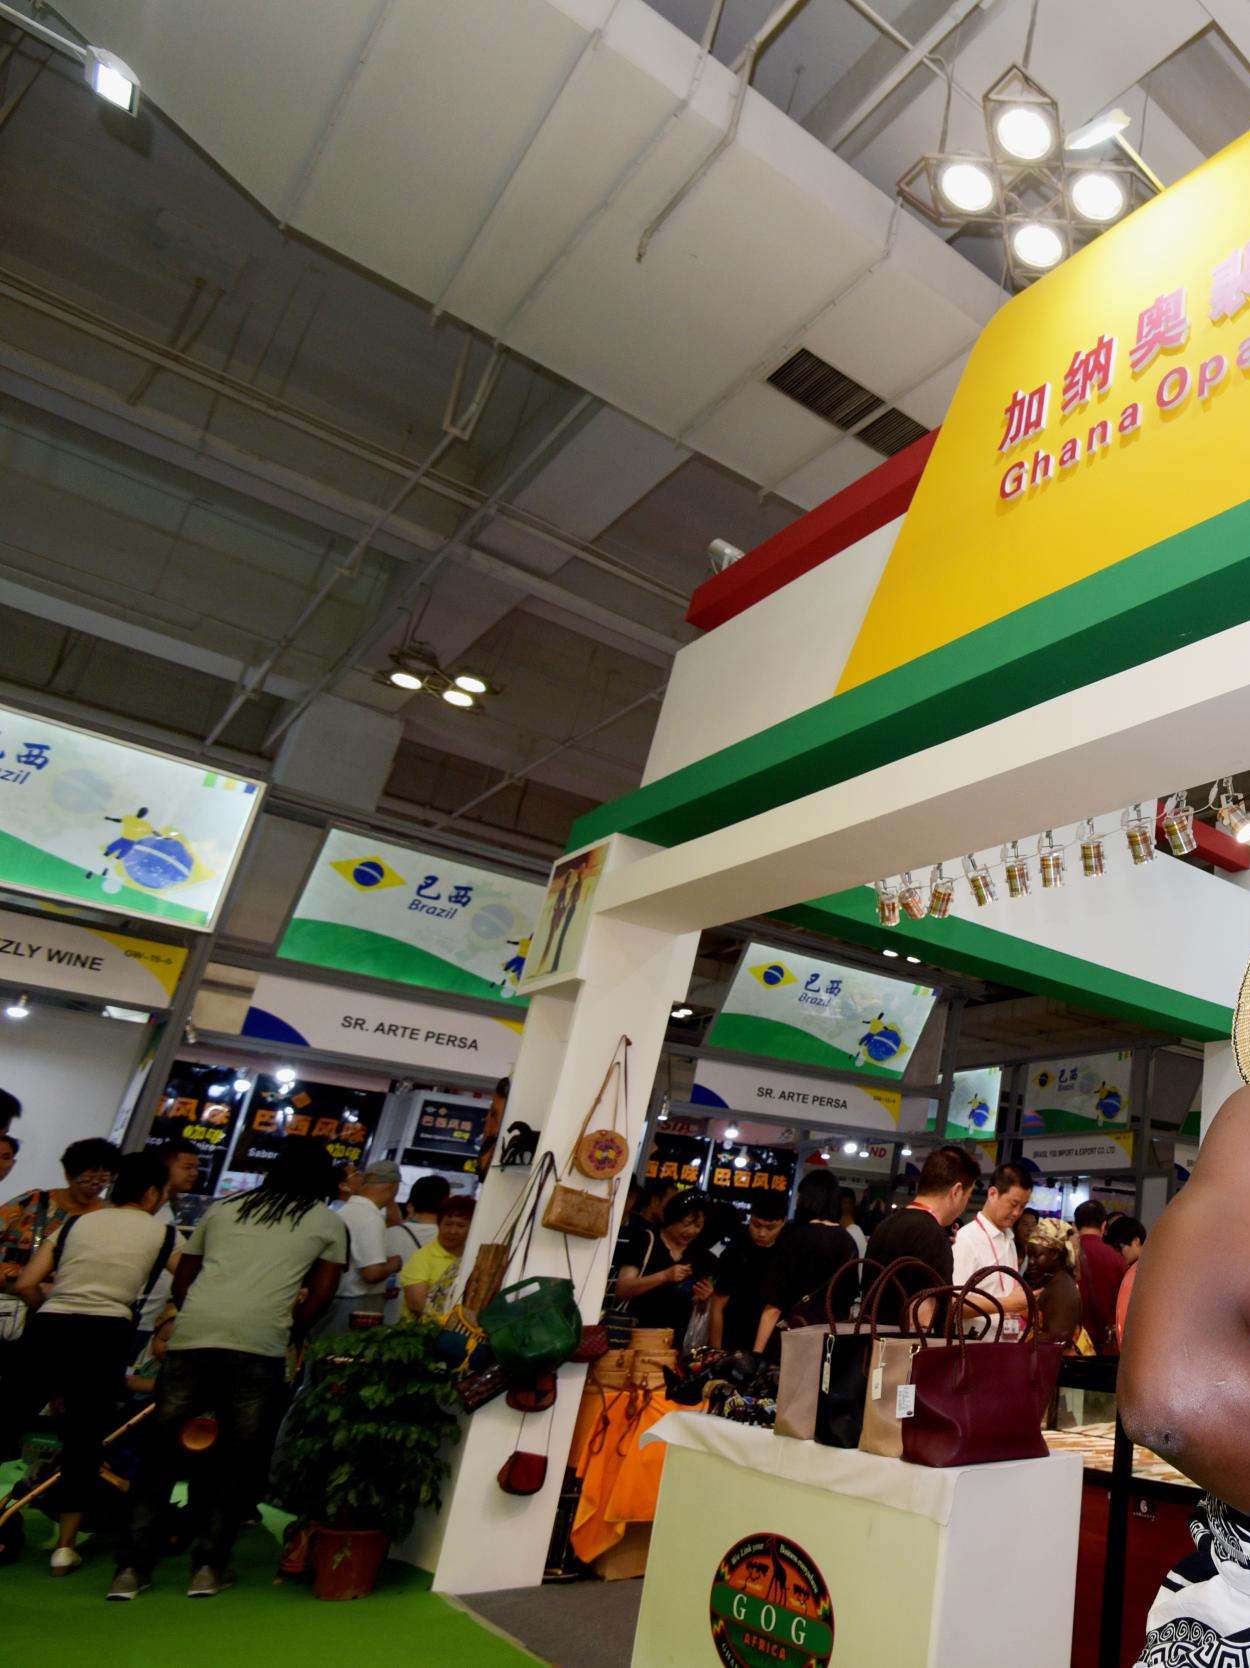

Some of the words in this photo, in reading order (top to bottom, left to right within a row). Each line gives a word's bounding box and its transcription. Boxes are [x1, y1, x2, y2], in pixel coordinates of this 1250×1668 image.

[1000, 402, 1141, 501] Ghana
[416, 875, 474, 908] 巴西
[408, 898, 458, 920] Brazil
[48, 948, 104, 972] WINE
[804, 972, 842, 997] 巴西
[798, 992, 832, 1008] Brazil
[341, 1015, 369, 1032] SR.
[374, 1022, 421, 1041] ARTE
[424, 1030, 479, 1052] PERSA
[756, 1087, 776, 1101] SR.
[778, 1090, 810, 1105] ARTE
[811, 1095, 848, 1110] PERSA
[743, 1632, 787, 1660] AFRICA
